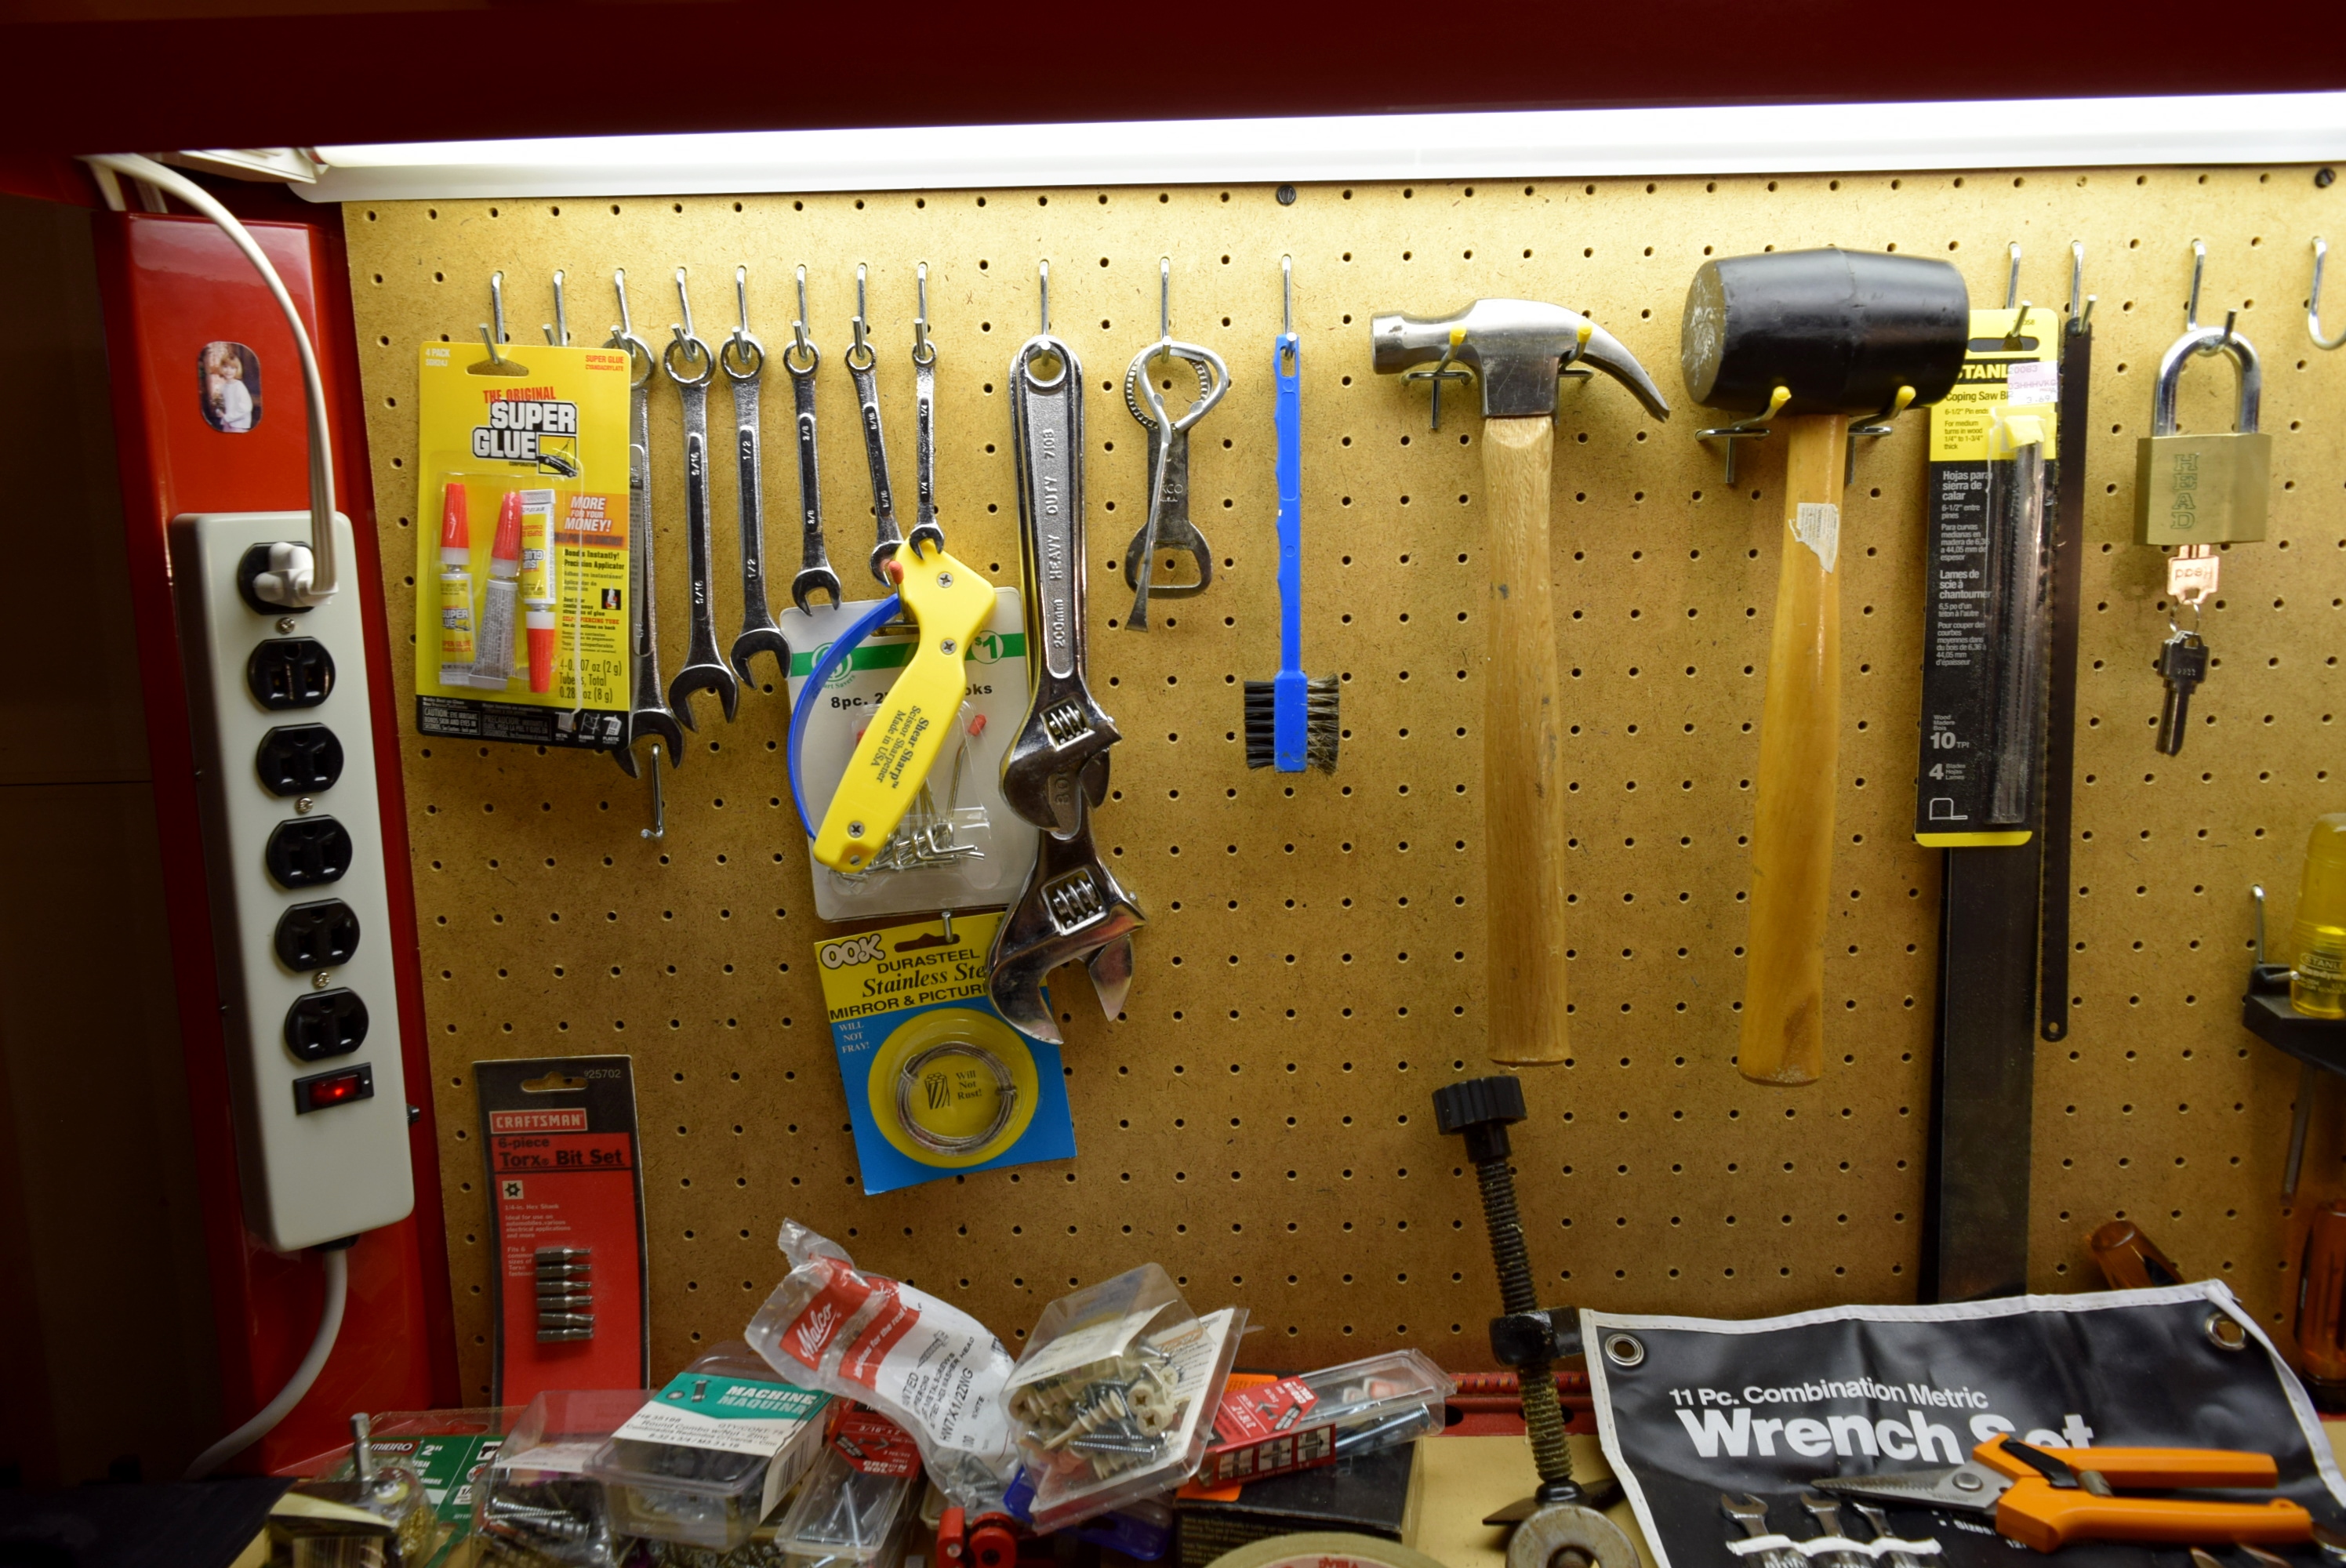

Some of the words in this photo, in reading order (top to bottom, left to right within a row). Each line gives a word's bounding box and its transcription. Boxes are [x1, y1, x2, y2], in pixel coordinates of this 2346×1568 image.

[585, 354, 606, 364] SUPER
[1959, 364, 2007, 379] TANL
[483, 390, 502, 404] THE
[507, 387, 556, 401] ORIGINAL
[1946, 392, 1976, 402] Coping
[491, 401, 576, 433] SUPER
[474, 429, 536, 459] GLUE
[1943, 471, 1969, 482] Hojas
[1970, 473, 1992, 481] para
[1942, 481, 1969, 491] sierra
[1970, 481, 1982, 490] de
[2170, 454, 2199, 530] HEAD
[571, 495, 605, 510] MORE
[1045, 475, 1058, 515] DUTY
[1942, 491, 1966, 500] calar
[565, 517, 612, 532] MONEY!
[565, 549, 585, 557] Bonds
[587, 550, 619, 560] Instantly!
[1049, 534, 1062, 580] HEAVY
[565, 559, 592, 568] Precision
[594, 561, 624, 571] Applicator
[1940, 570, 1967, 579] Lames
[1969, 569, 1980, 579] de
[1940, 579, 1957, 589] scie
[1958, 579, 1963, 589] à
[1940, 590, 1992, 599] chantourner
[1054, 599, 1064, 648] 200mm
[603, 660, 611, 674] (2
[614, 661, 622, 676] g)
[559, 672, 586, 687] Tubes,
[589, 674, 607, 687] Total
[834, 674, 856, 689] Savers
[559, 687, 576, 699] 0.28
[594, 688, 602, 702] (8
[605, 688, 612, 703] g)
[830, 696, 868, 710] 8pc.
[888, 710, 906, 735] Made
[900, 706, 921, 737] Scissor
[882, 735, 894, 745] in
[908, 717, 929, 747] Shear
[1930, 732, 1956, 749] 10
[870, 746, 888, 767] USA
[877, 738, 905, 783] Sharpener
[1929, 764, 1944, 780] 4
[820, 934, 886, 969] OOK
[877, 949, 980, 974] DURASTEEL
[862, 967, 948, 998] Stainless
[954, 962, 986, 982] Ste
[829, 996, 899, 1021] MIRROR
[903, 994, 915, 1007] &
[839, 1021, 864, 1032] WILL
[843, 1032, 864, 1043] NOT
[841, 1040, 870, 1054] FRAY!
[584, 1069, 621, 1079] 925702
[956, 1070, 975, 1080] Will
[960, 1081, 976, 1090] Not
[957, 1088, 982, 1100] Rust!
[499, 1138, 550, 1149] 6-piece
[556, 1150, 583, 1165] Bit
[590, 1149, 623, 1164] Set
[881, 1323, 892, 1338] the
[892, 1307, 905, 1326] real
[797, 1302, 832, 1362] Malco
[960, 1337, 975, 1359] HEAD
[935, 1352, 956, 1384] SCREWS
[726, 1385, 818, 1405] MACHINE
[1669, 1389, 1694, 1406] 11
[1698, 1388, 1739, 1406] Pc.
[1744, 1377, 1908, 1405] Combination
[1907, 1383, 1989, 1409] Metric
[717, 1396, 809, 1414] MAQUINA
[1676, 1408, 1965, 1465] Wrench
[371, 1443, 413, 1451] MIBRO
[421, 1445, 443, 1456] 2"
[1953, 1519, 1996, 1536] Sizes:
